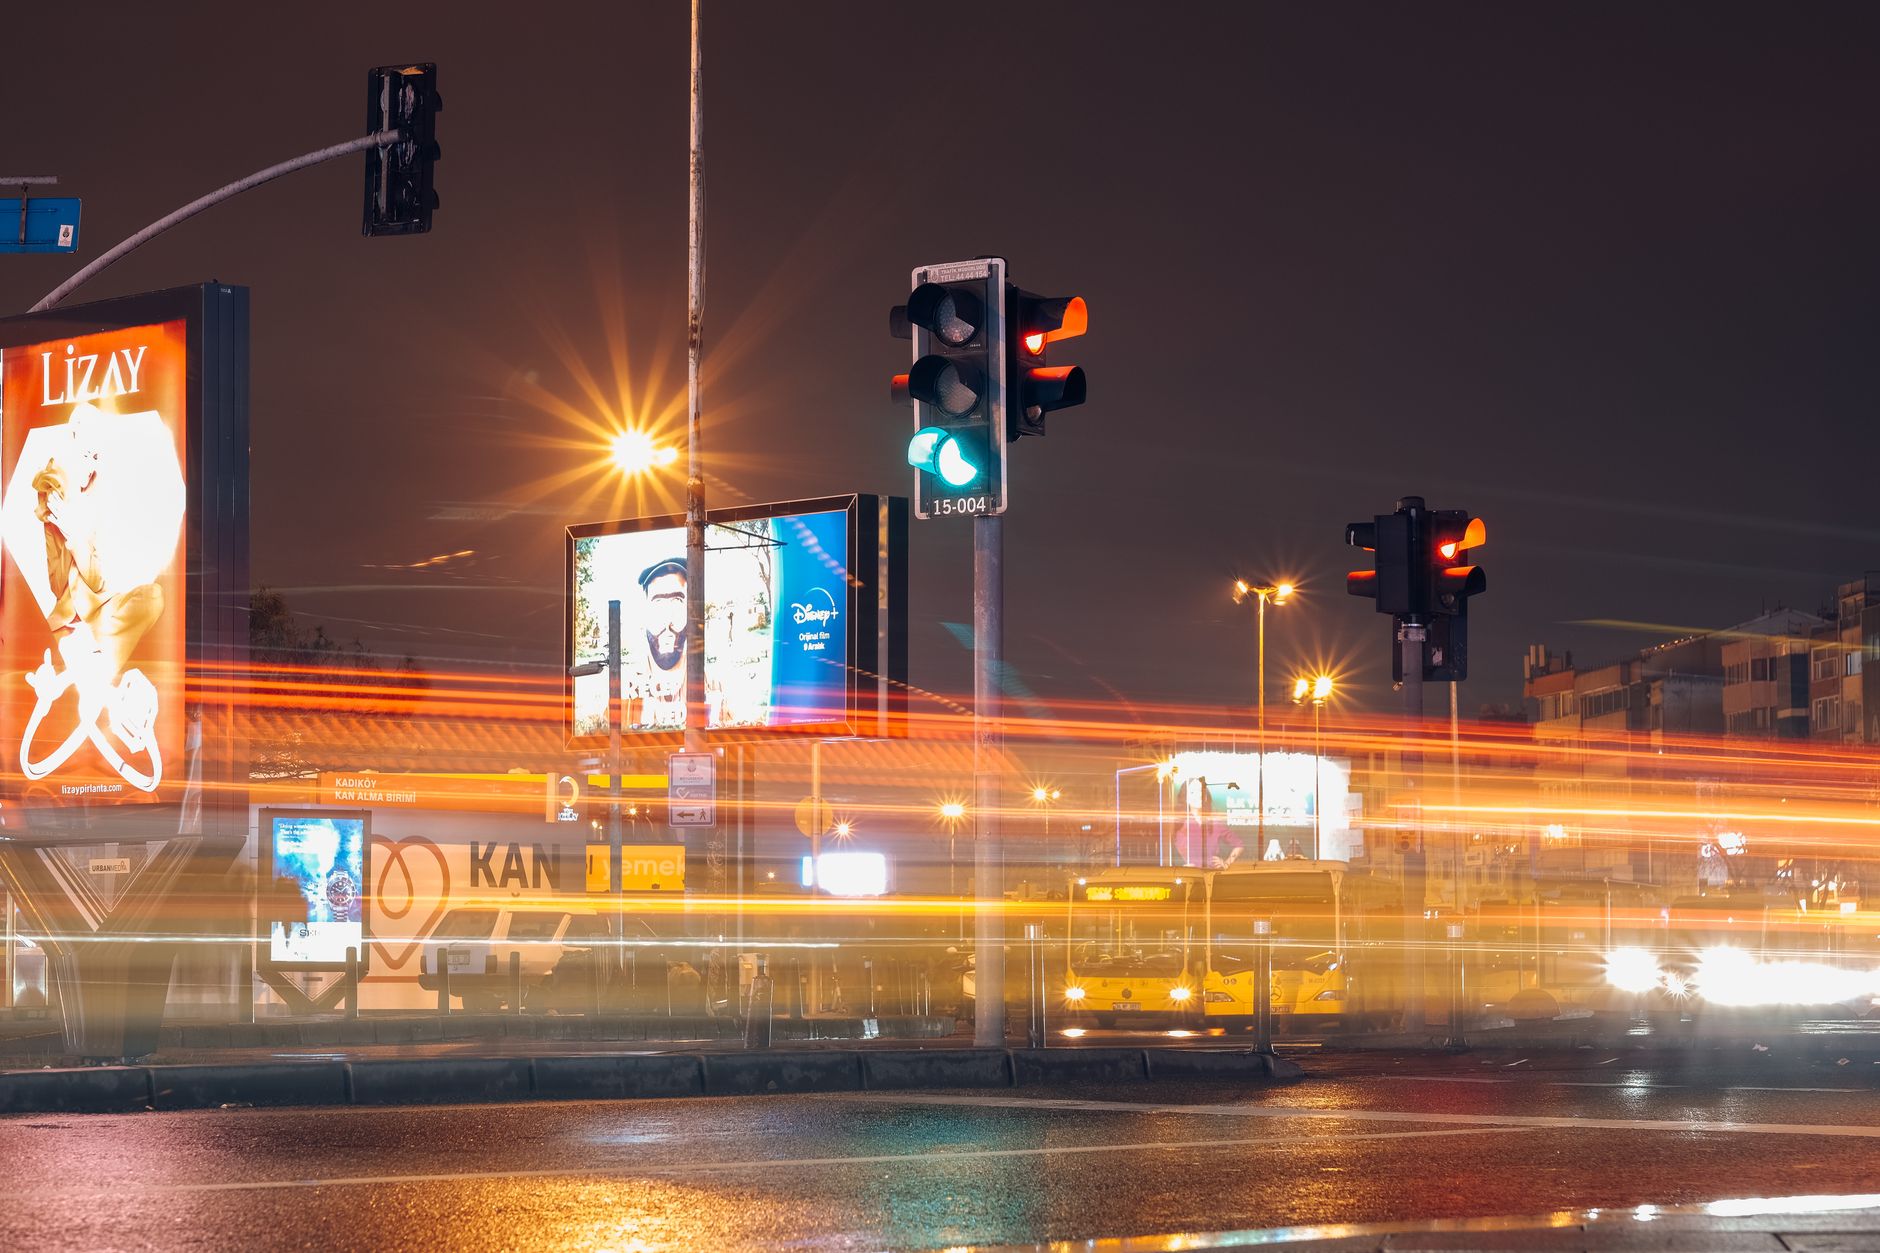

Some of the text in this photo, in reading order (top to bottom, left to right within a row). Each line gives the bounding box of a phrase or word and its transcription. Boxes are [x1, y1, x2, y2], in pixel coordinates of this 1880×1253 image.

[933, 496, 986, 515] 15-004
[61, 784, 122, 795] lizaypirlanta.com
[335, 777, 377, 789] KADIKÖY
[335, 790, 416, 803] KAN ALMA BİRİMİ
[470, 841, 561, 889] KAN
